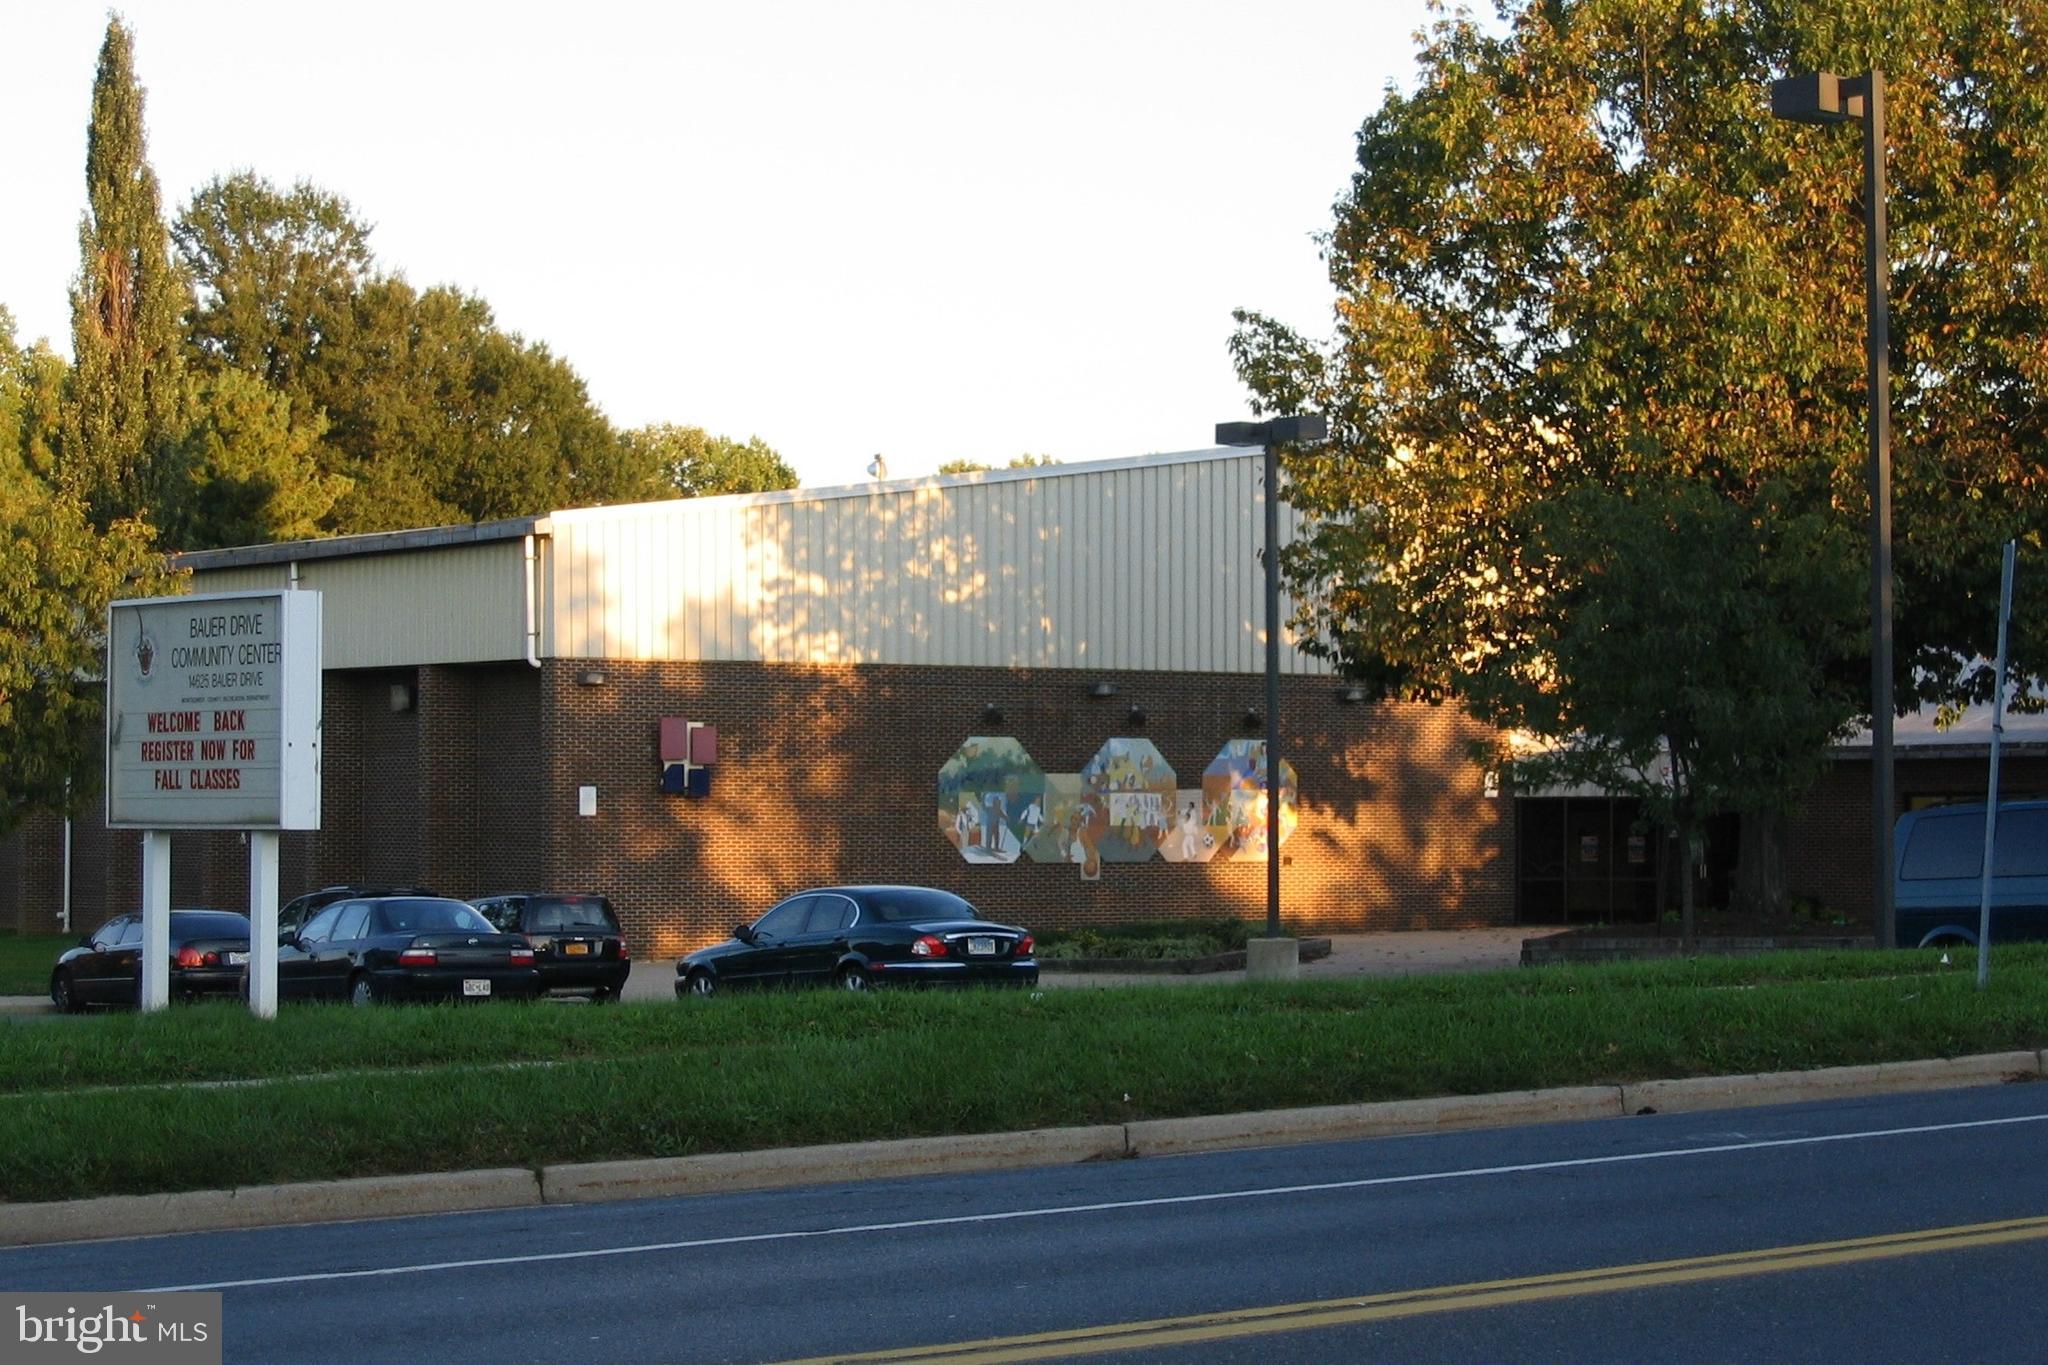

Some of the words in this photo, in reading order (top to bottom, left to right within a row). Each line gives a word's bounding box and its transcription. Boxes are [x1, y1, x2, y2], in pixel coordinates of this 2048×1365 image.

[190, 616, 226, 638] BAUER
[230, 614, 263, 636] DRIVE
[171, 645, 235, 668] COMMUNITY
[238, 643, 282, 665] CENTER
[211, 672, 238, 688] BAUER
[240, 671, 263, 687] DRIVE
[148, 711, 201, 733] WELCOME
[214, 709, 245, 732] BACK
[141, 740, 194, 762] REGISTER
[201, 739, 226, 761] NOW
[232, 739, 255, 760] FOR
[154, 768, 182, 790] FALL
[190, 768, 241, 790] CLASSES
